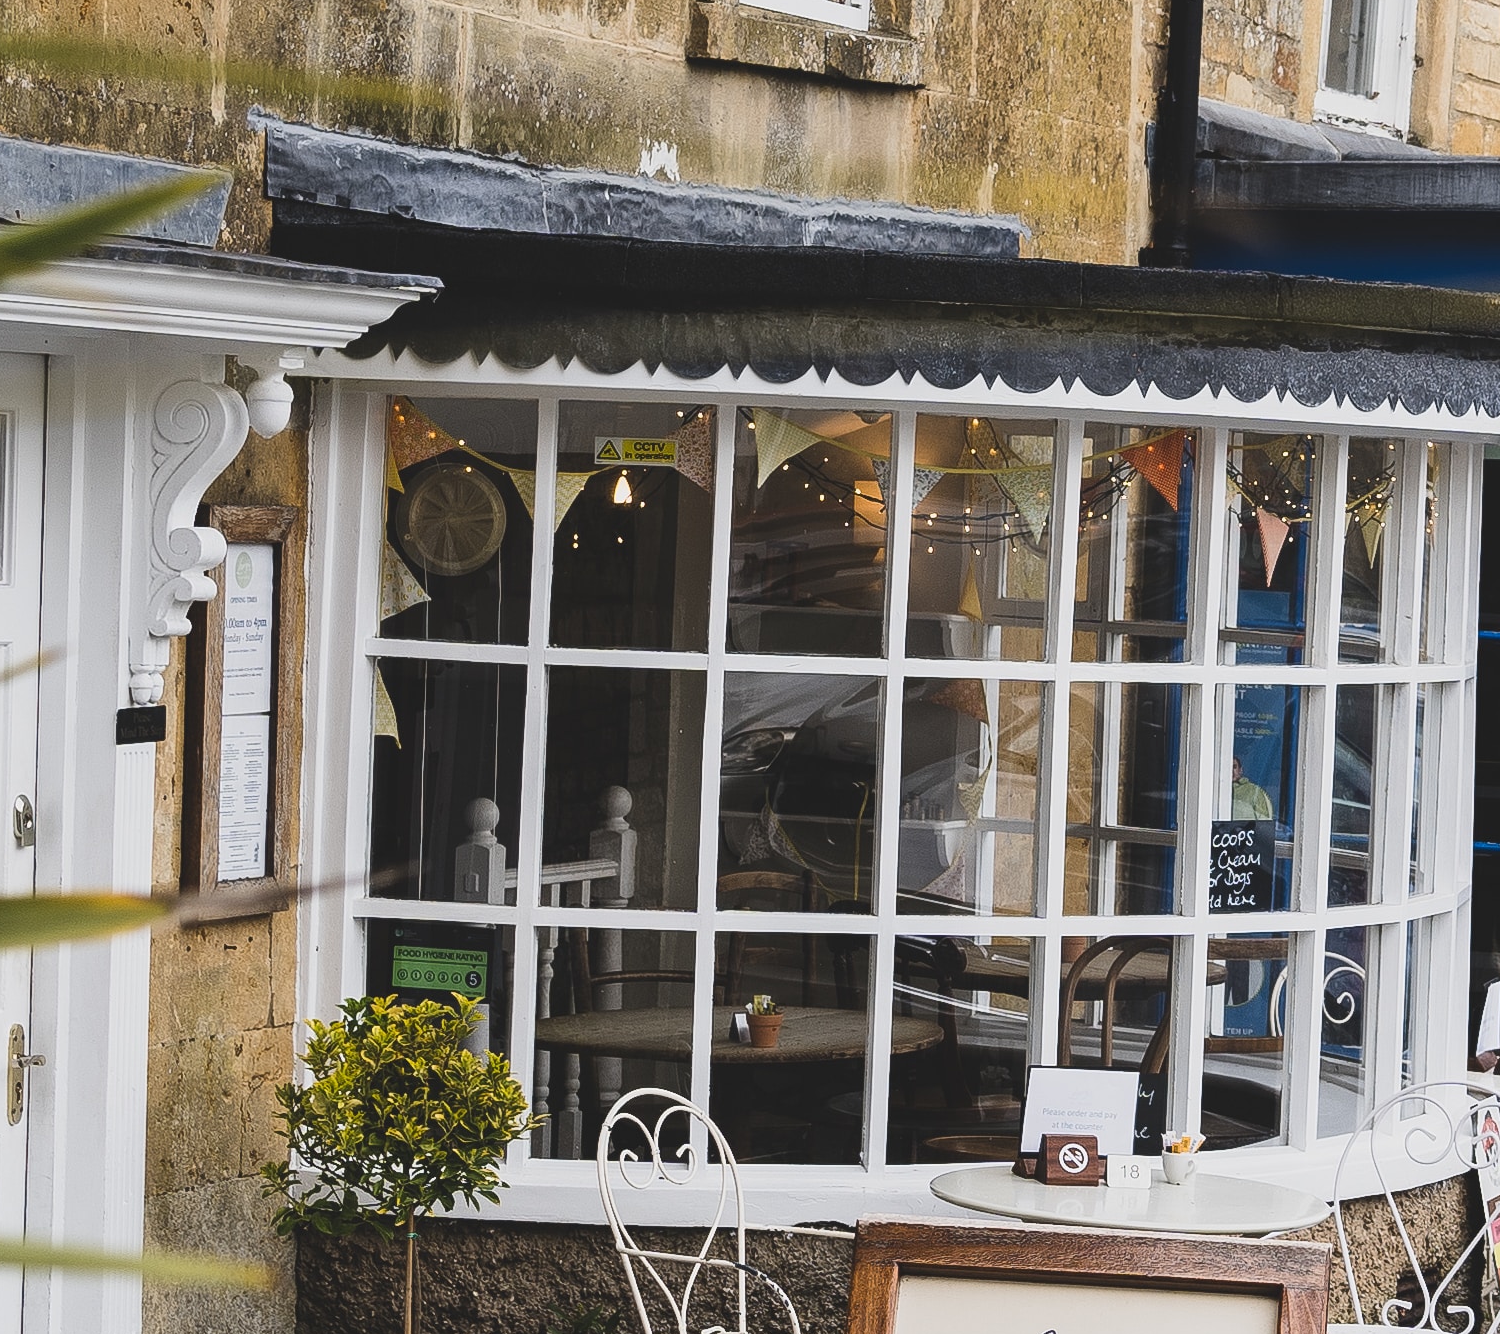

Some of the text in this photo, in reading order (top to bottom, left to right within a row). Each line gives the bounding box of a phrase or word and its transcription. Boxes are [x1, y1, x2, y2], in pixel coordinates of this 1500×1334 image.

[633, 441, 666, 452] CCTV
[634, 453, 675, 461] operation
[1212, 830, 1255, 847] COOPS
[1209, 867, 1254, 895] or Dogs
[397, 948, 483, 962] FOOD HYGIENE RATING
[1042, 1107, 1066, 1117] Please
[1067, 1109, 1088, 1118] order
[1061, 1121, 1074, 1129] the
[1120, 1164, 1140, 1180] 18
